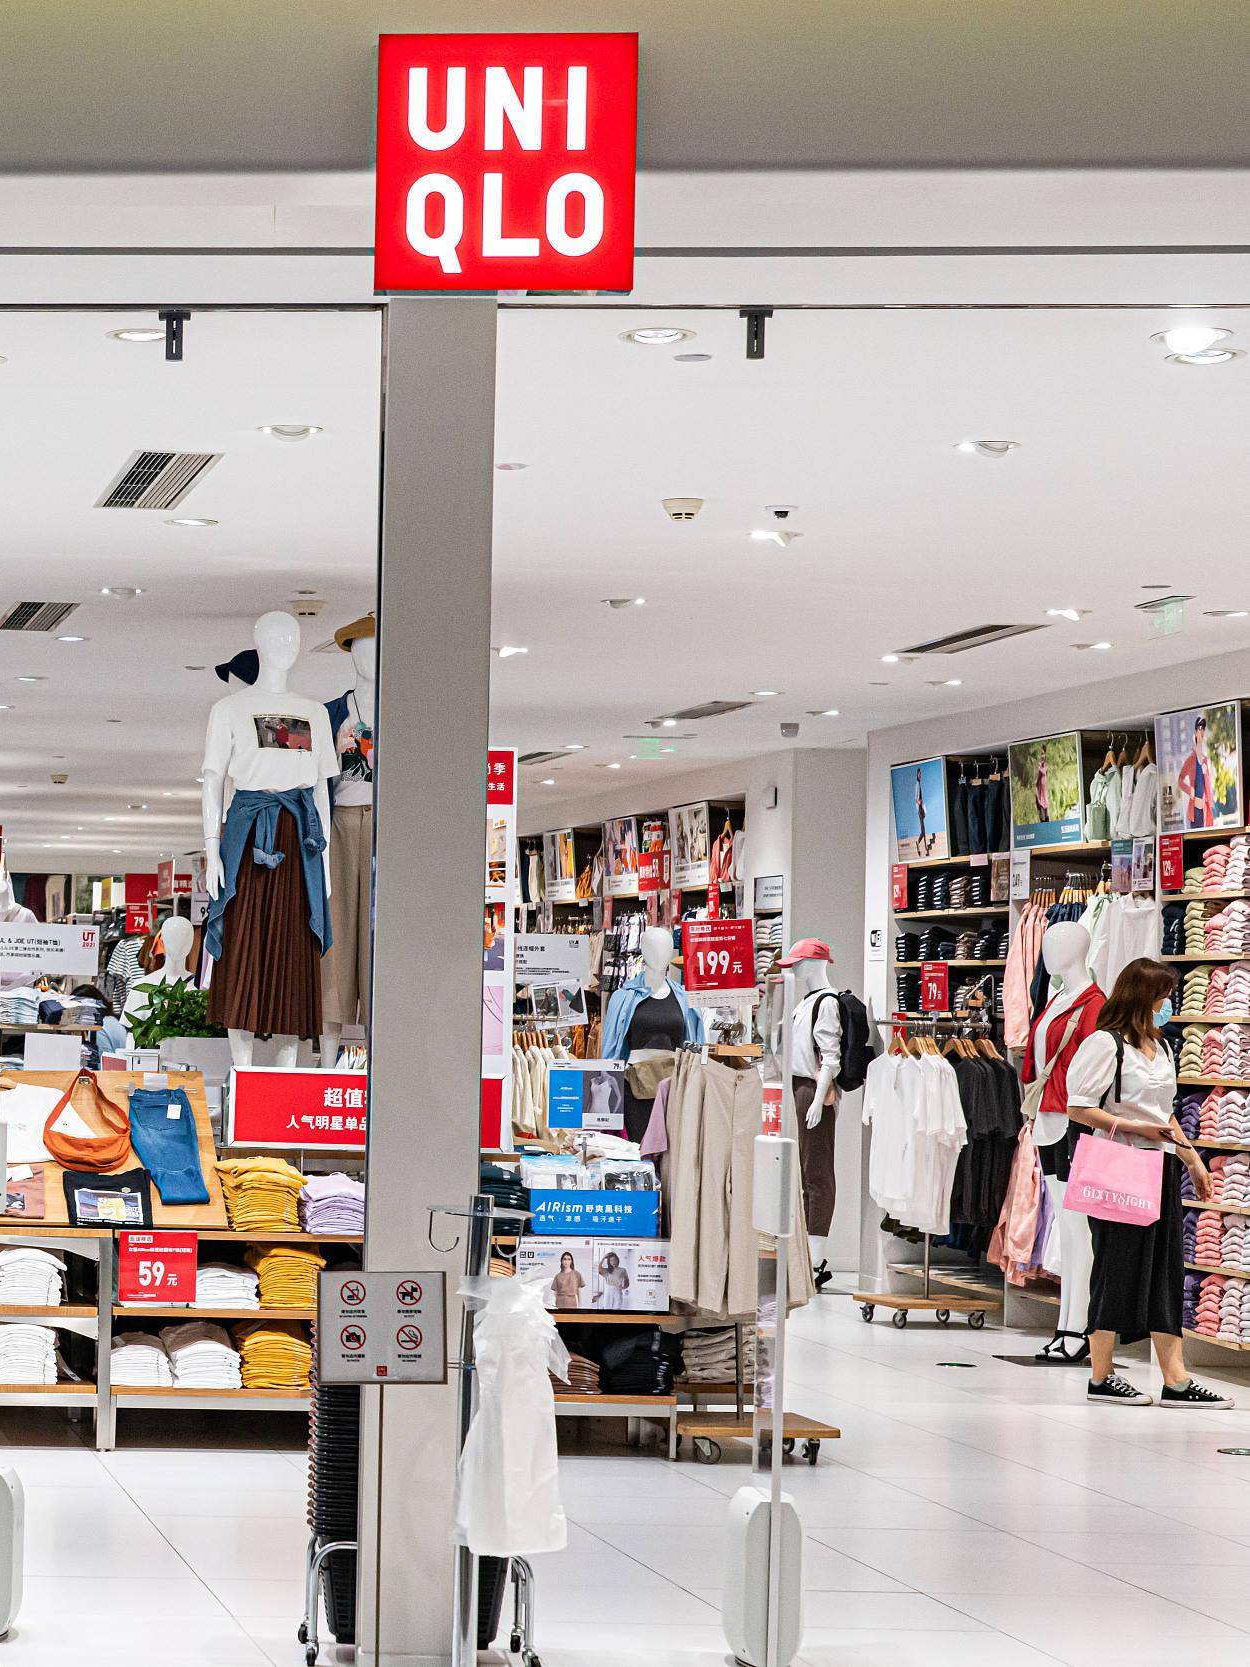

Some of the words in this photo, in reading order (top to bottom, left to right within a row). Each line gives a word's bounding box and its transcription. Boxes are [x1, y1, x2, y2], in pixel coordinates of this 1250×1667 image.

[407, 66, 587, 151] UNI
[405, 172, 604, 274] QLO
[82, 931, 96, 941] UT
[323, 1086, 367, 1108] 超值
[535, 1201, 583, 1213] AIRism
